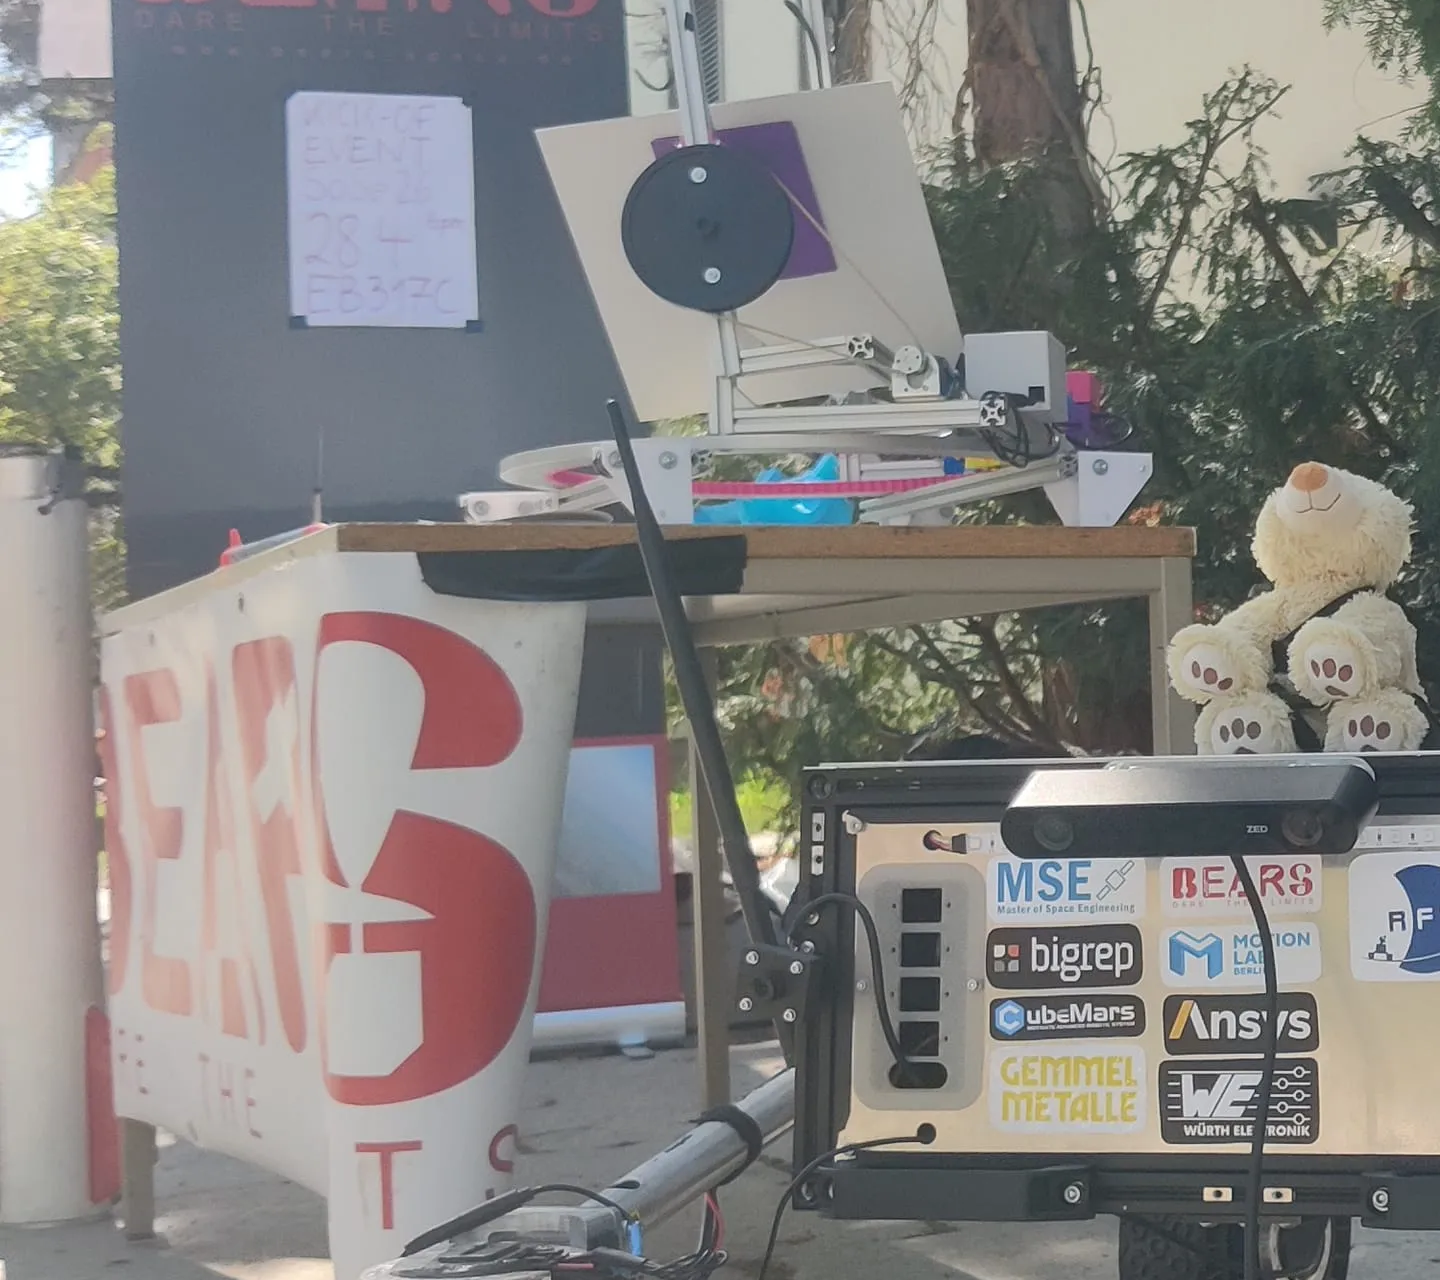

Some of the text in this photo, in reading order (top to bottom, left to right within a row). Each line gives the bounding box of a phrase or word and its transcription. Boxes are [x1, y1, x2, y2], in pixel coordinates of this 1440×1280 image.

[321, 14, 394, 37] THE
[305, 136, 431, 167] EVENT
[1246, 825, 1268, 833] ZED
[997, 860, 1092, 903] MSE
[997, 903, 1135, 915] Master of Space Engineering
[1234, 932, 1310, 948] MOION
[1031, 936, 1134, 982] bigrep
[998, 1003, 1135, 1030] CubeMars
[1000, 1056, 1137, 1087] GEMMEL
[1002, 1091, 1137, 1122] METALLE
[1181, 1074, 1263, 1117] WE
[1184, 1122, 1229, 1136] WÜRTH
